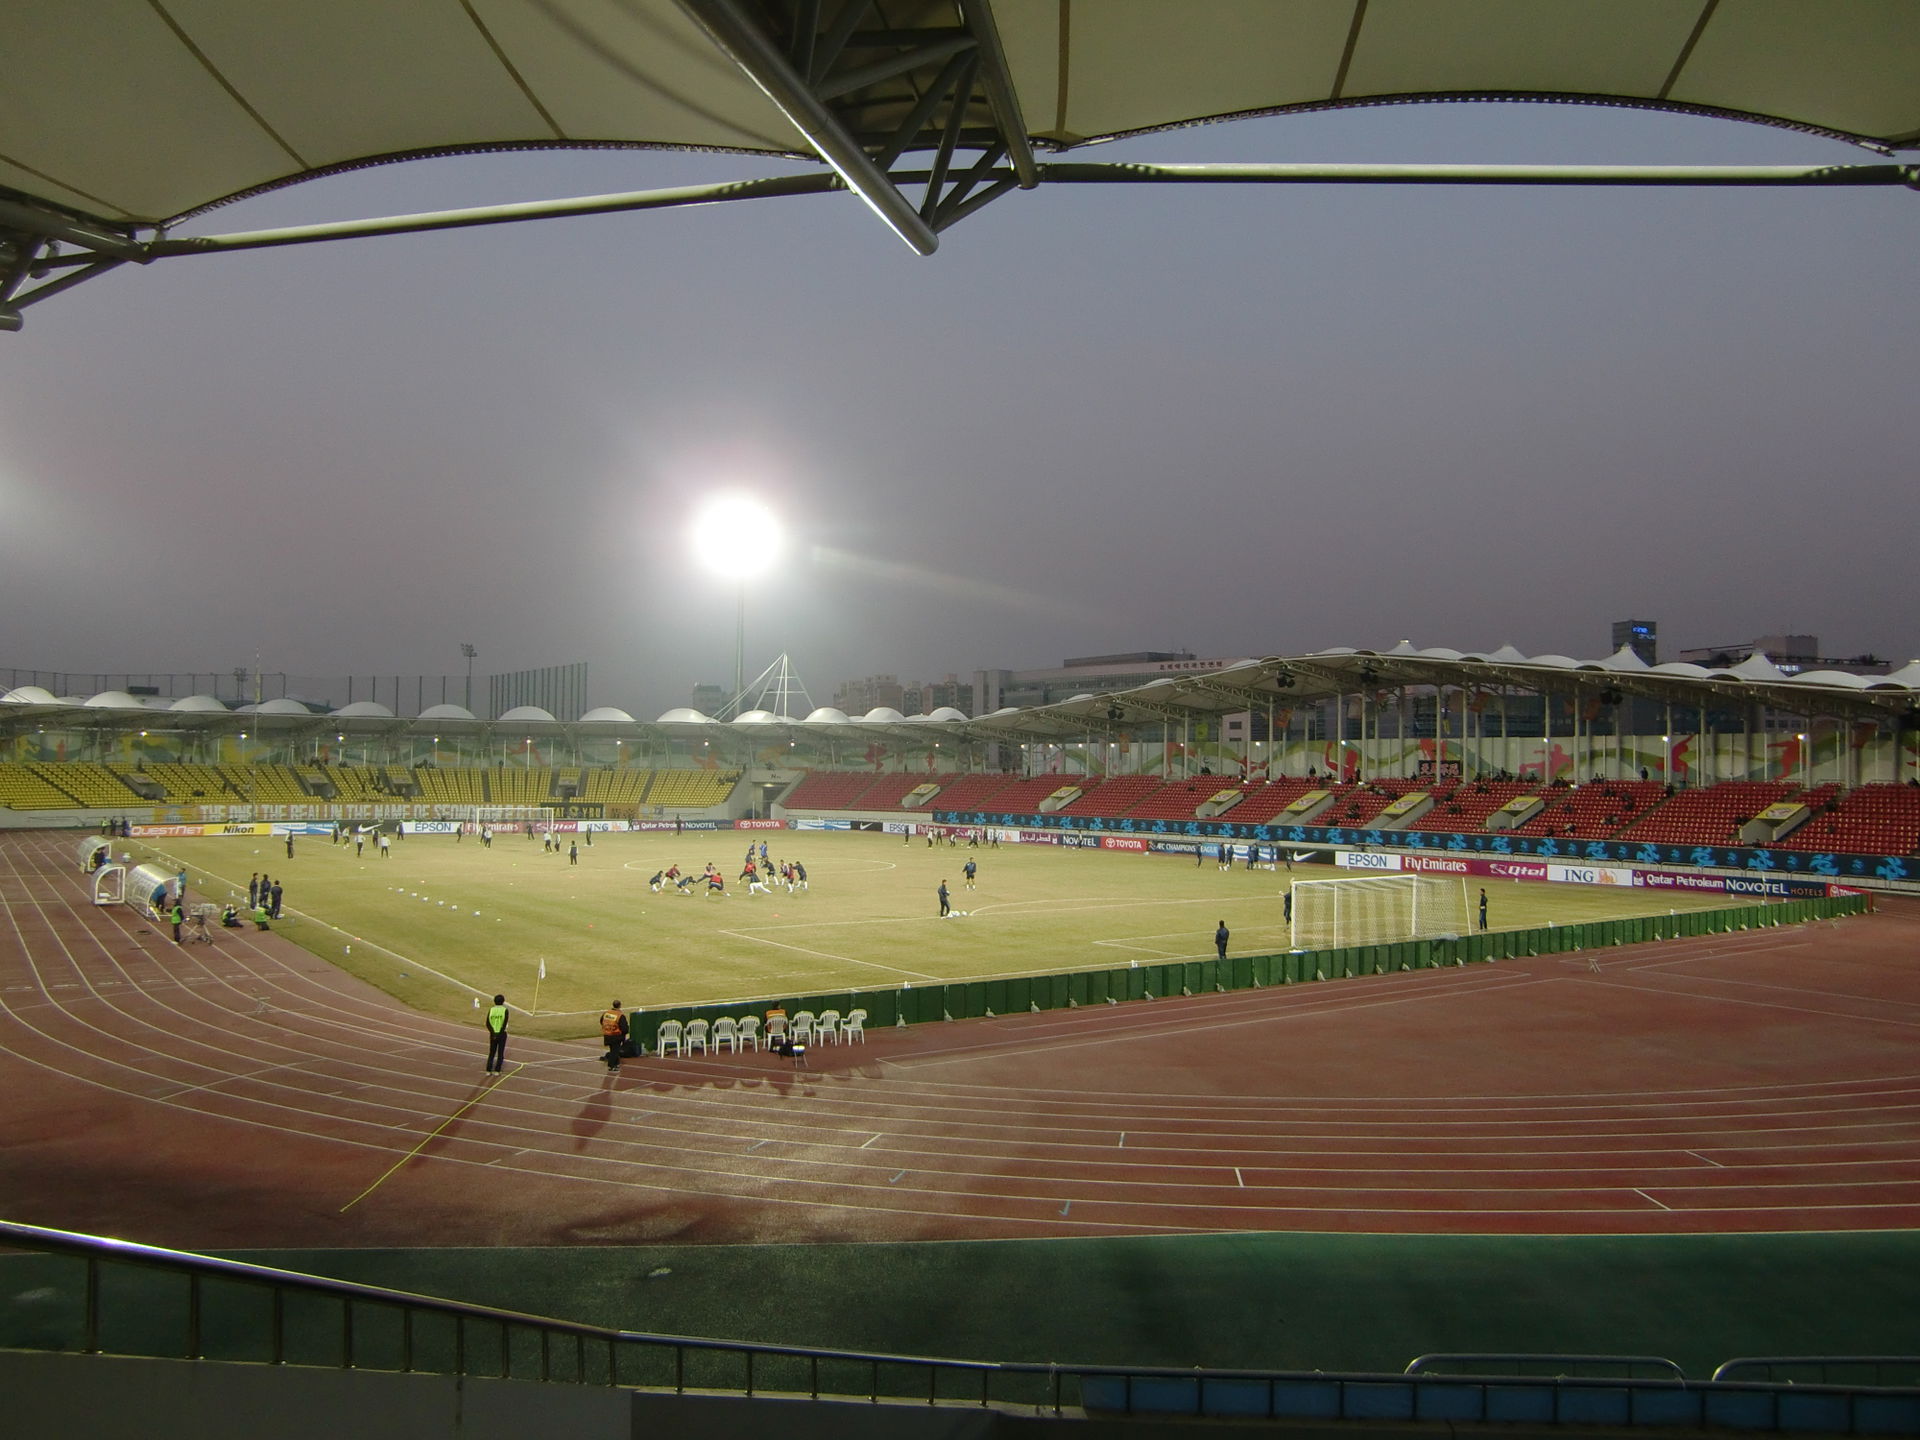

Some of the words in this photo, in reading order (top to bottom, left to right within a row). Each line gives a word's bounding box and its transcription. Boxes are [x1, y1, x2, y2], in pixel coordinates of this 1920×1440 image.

[347, 804, 371, 820] THE
[223, 825, 255, 834] Nikon
[415, 823, 451, 832] EPSON
[1116, 839, 1142, 849] TOYOTA
[1348, 853, 1387, 867] EPSON
[1405, 856, 1422, 871] Fly
[1423, 857, 1467, 872] Emirates
[1508, 865, 1545, 876] Qtel
[1564, 868, 1594, 882] ING
[1646, 874, 1674, 885] Qatar
[1676, 876, 1723, 888] Petroleum
[1726, 879, 1789, 894] NOVOTEL
[1790, 887, 1824, 896] HOTELS
